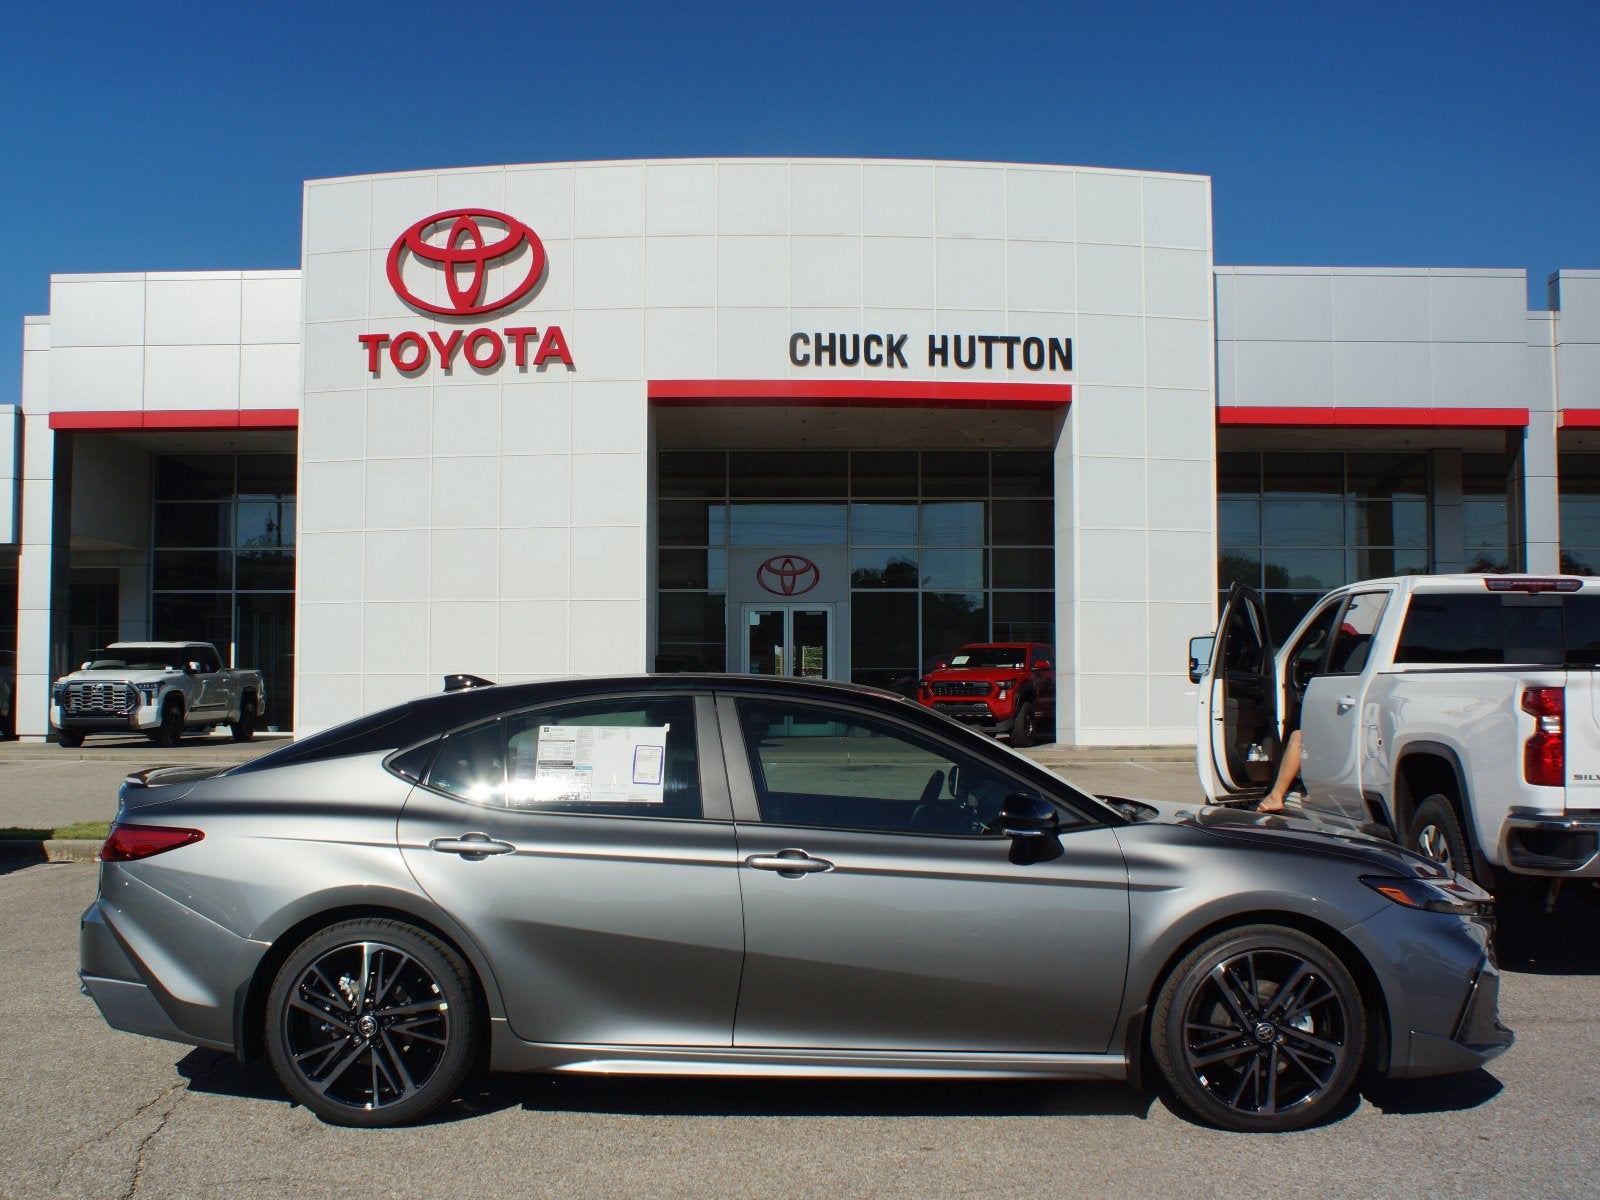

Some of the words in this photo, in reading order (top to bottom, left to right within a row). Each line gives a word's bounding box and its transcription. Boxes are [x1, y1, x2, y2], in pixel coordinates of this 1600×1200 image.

[358, 326, 574, 373] TOYOTA
[789, 332, 909, 368] CHUCK
[928, 334, 1073, 371] HUTTON
